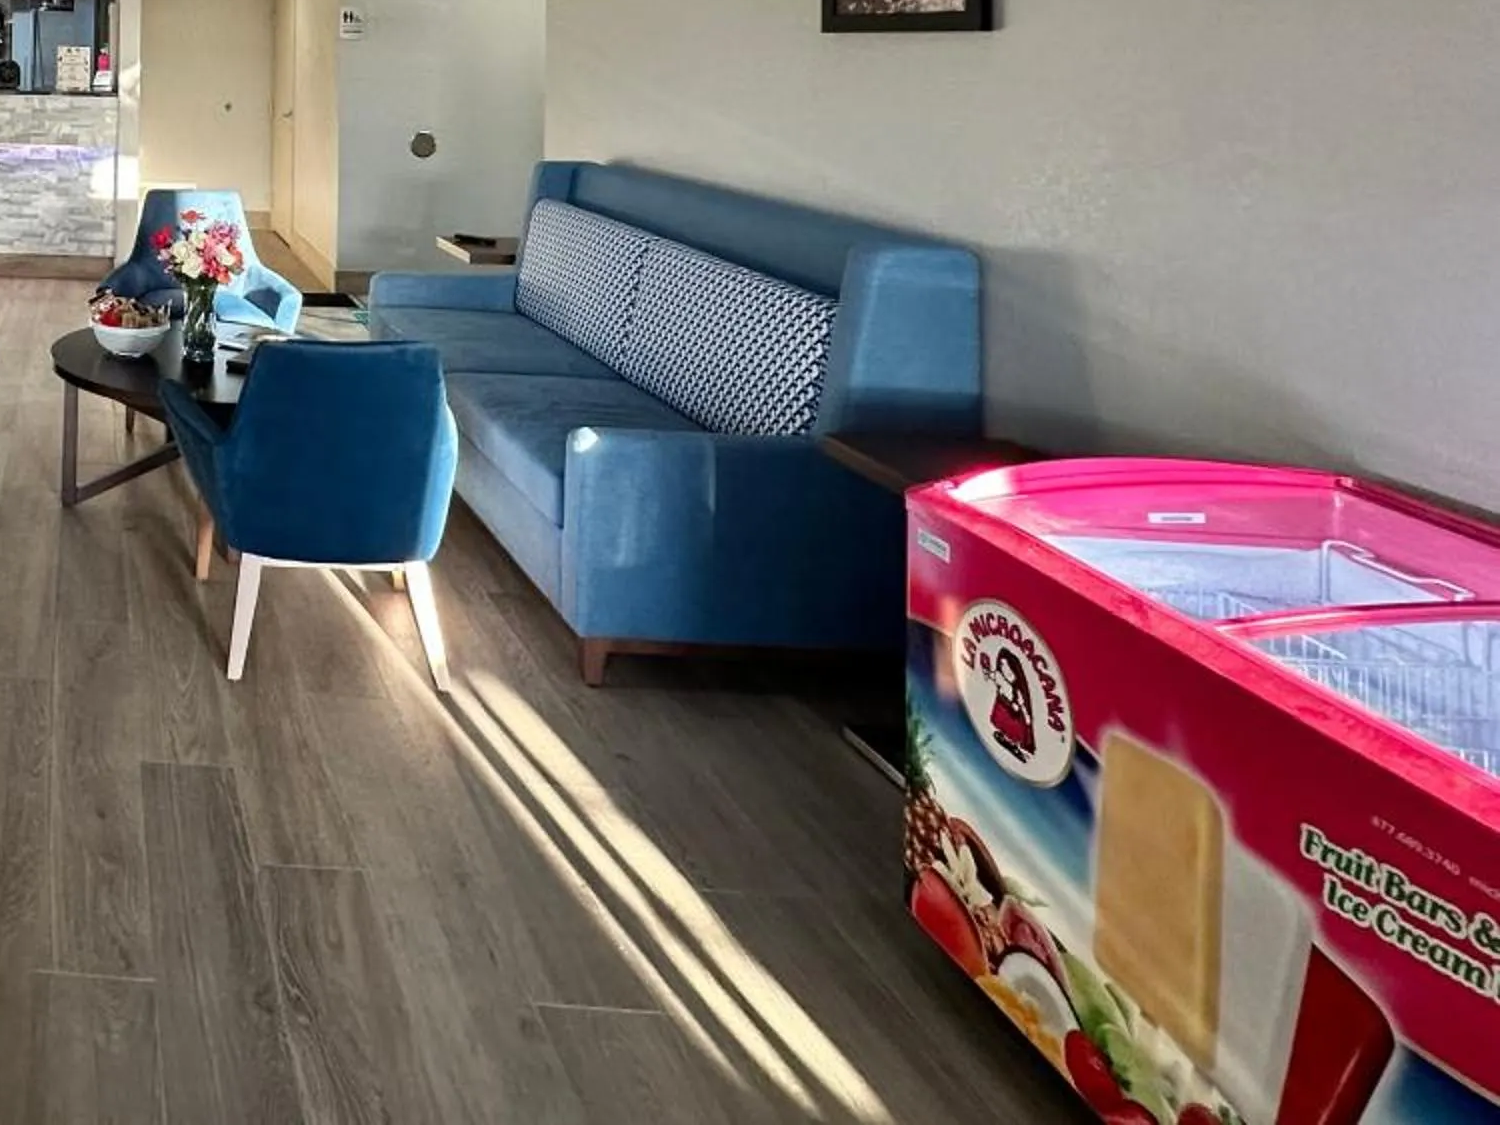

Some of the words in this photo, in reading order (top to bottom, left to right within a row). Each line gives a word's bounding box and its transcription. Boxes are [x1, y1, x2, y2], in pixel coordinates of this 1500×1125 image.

[961, 636, 977, 670] LA
[969, 612, 1066, 733] MICHOACANA
[1302, 825, 1378, 891] Fruit
[1381, 866, 1465, 936] Bars
[1471, 914, 1500, 956] &
[1325, 877, 1370, 924] Ice
[1373, 905, 1487, 993] Cream
